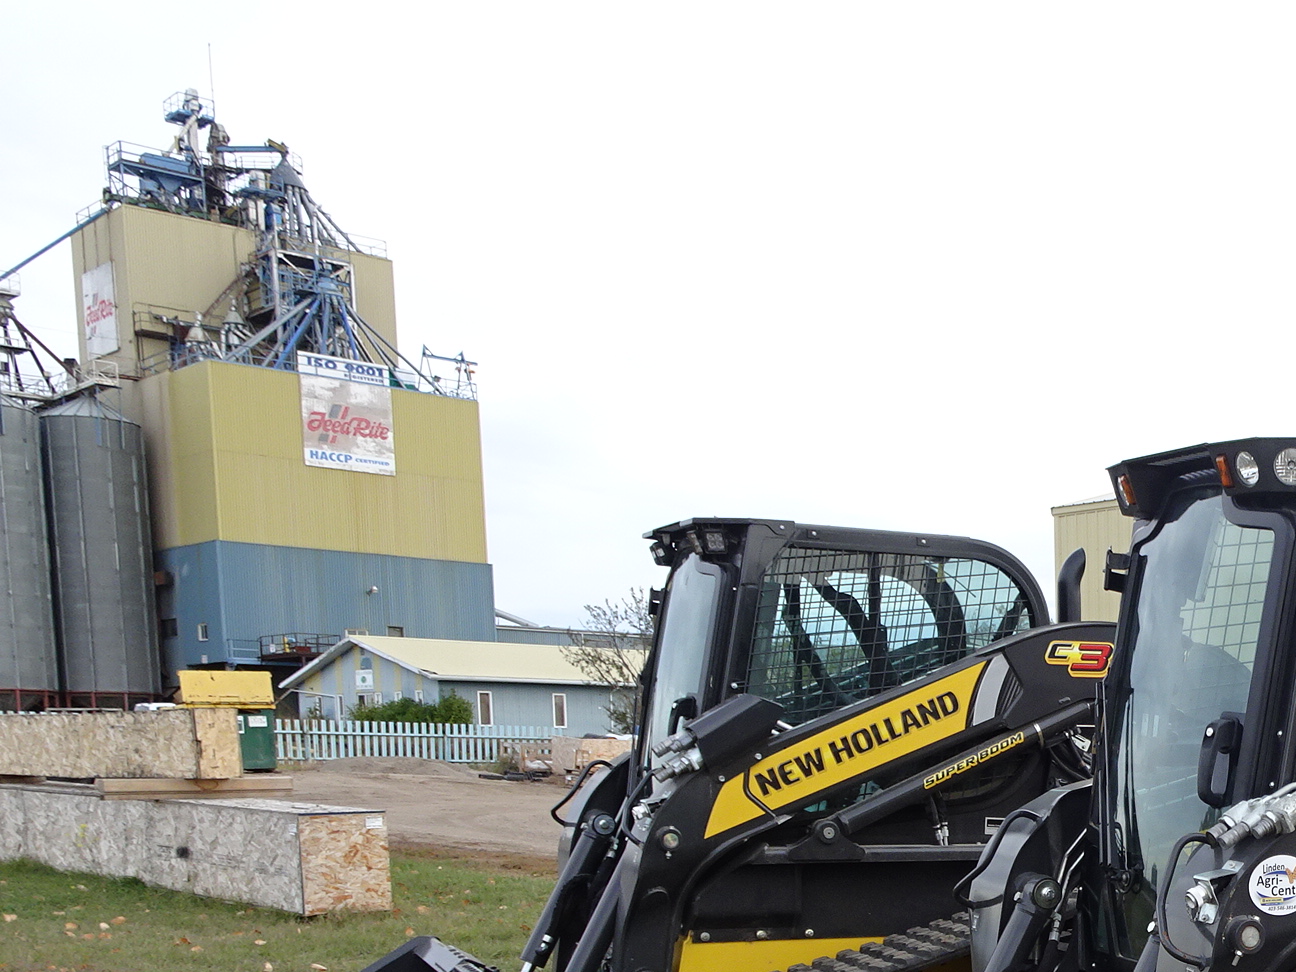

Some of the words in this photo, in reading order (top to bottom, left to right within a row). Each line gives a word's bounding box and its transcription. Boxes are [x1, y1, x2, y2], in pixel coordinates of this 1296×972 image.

[307, 357, 337, 370] ISO
[345, 363, 383, 377] 9001
[344, 373, 384, 384] RGISTERED
[309, 449, 353, 463] HACCP
[355, 458, 390, 467] CERTIFIED
[754, 747, 826, 797] NEW
[828, 691, 960, 765] HOLLAND
[924, 755, 977, 789] SUPER
[978, 732, 1025, 763] BOOM
[1262, 863, 1286, 874] Linden
[1257, 874, 1283, 888] Agri-
